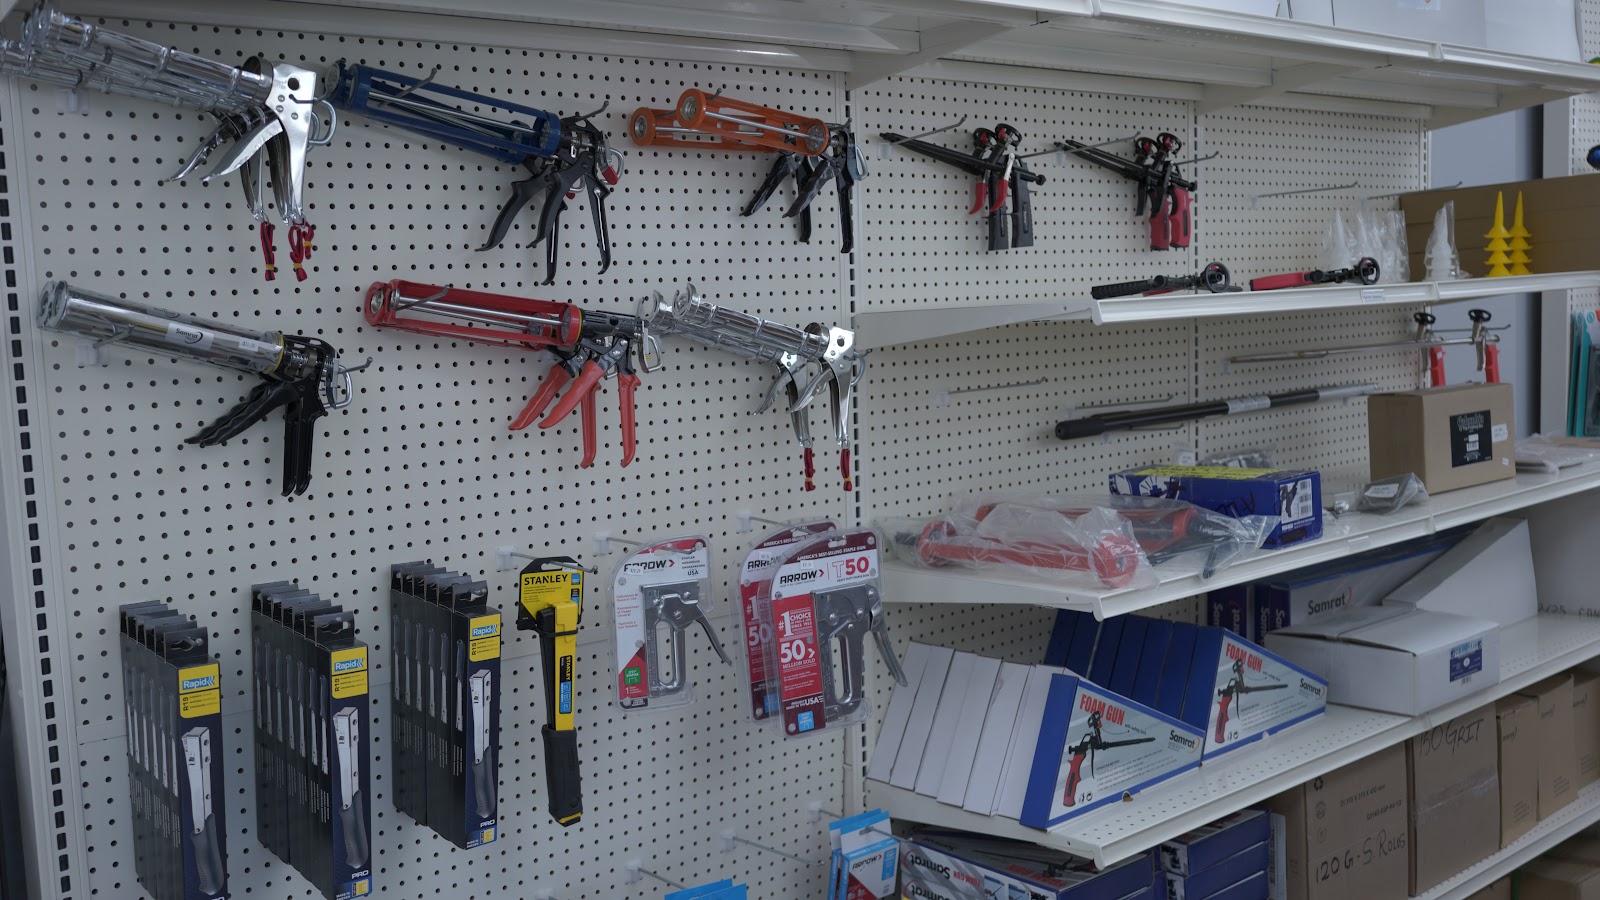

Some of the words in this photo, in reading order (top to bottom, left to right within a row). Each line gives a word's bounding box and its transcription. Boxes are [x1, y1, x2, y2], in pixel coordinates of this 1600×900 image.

[175, 327, 199, 340] Samrat
[797, 553, 818, 561] AMERICA'S
[818, 549, 843, 558] BEST-SELLING
[843, 546, 856, 554] STAPLE
[832, 556, 870, 578] T50
[524, 574, 568, 585] STANLEY
[780, 570, 818, 584] ARROW
[1308, 593, 1346, 616] Samrat
[778, 610, 794, 637] #1
[790, 611, 812, 621] CHOICE
[472, 625, 491, 636] Rapid
[748, 623, 771, 646] 50
[780, 639, 806, 663] 50
[1225, 642, 1248, 664] FOAM
[1247, 653, 1263, 672] GUN
[335, 660, 357, 670] Rapid
[782, 660, 803, 669] MILLION
[183, 677, 207, 689] Rapid
[1300, 678, 1321, 696] Samrat
[804, 697, 820, 706] USA
[1080, 693, 1107, 718] FOAM
[1106, 704, 1126, 726] GUN
[1169, 729, 1196, 749] Samrat
[1445, 718, 1485, 755] GRIT
[480, 819, 495, 828] PRO
[852, 856, 878, 870] ARROW
[910, 854, 951, 880] Samrat
[1315, 856, 1340, 883] 120
[351, 870, 369, 879] PRO
